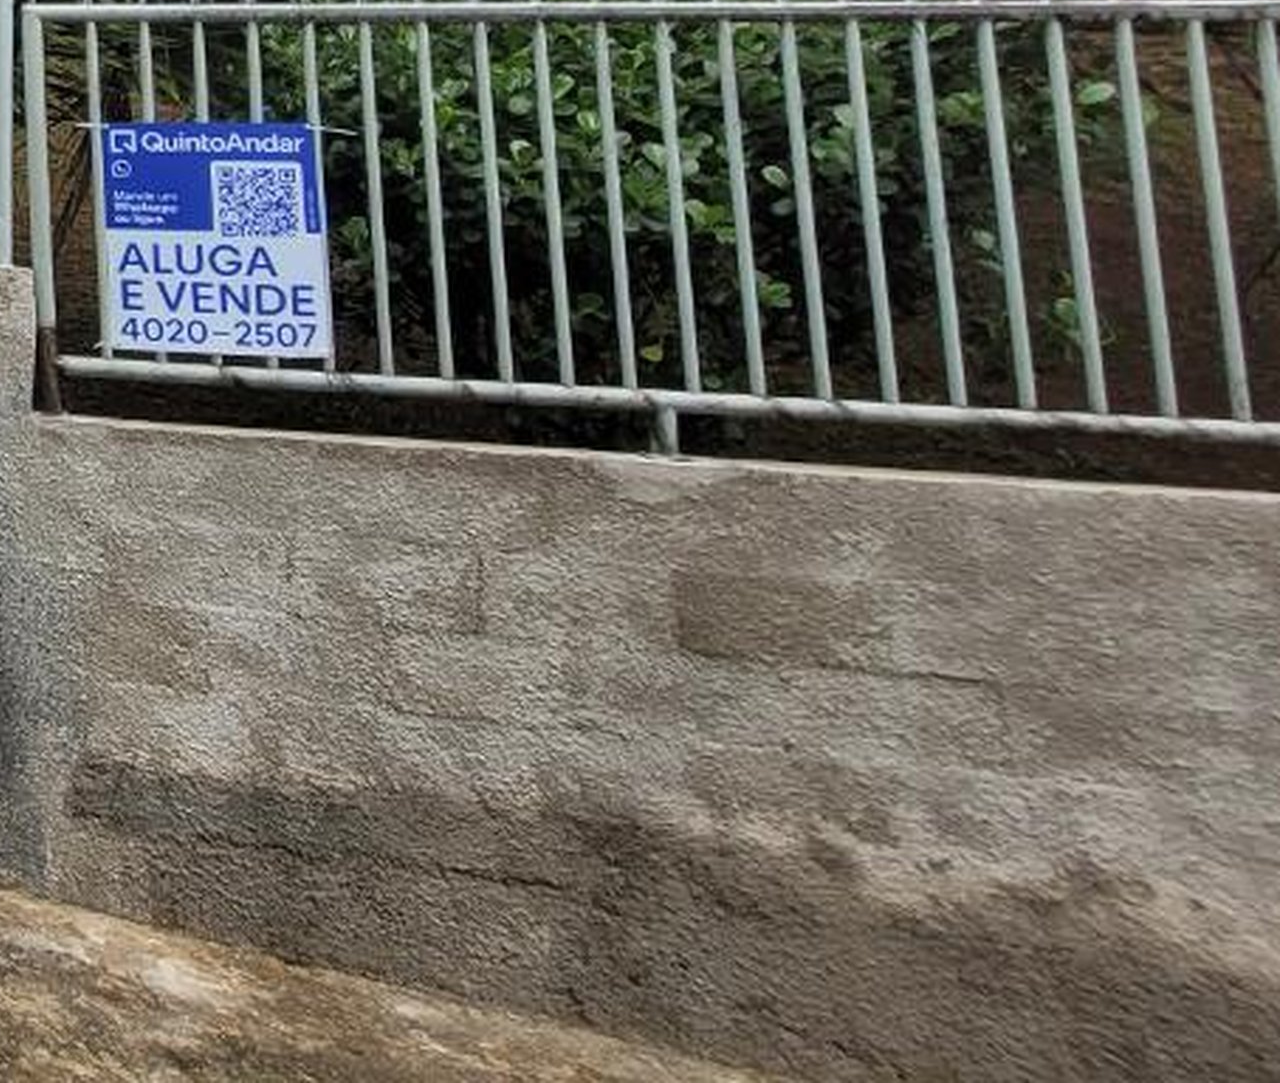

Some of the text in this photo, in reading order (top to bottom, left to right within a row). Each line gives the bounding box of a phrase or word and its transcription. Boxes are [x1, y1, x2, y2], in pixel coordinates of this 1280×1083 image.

[141, 130, 305, 154] QuintoAndar
[118, 242, 278, 277] ALUGA
[121, 280, 317, 316] E VENDE
[121, 318, 317, 348] 4020-2507
